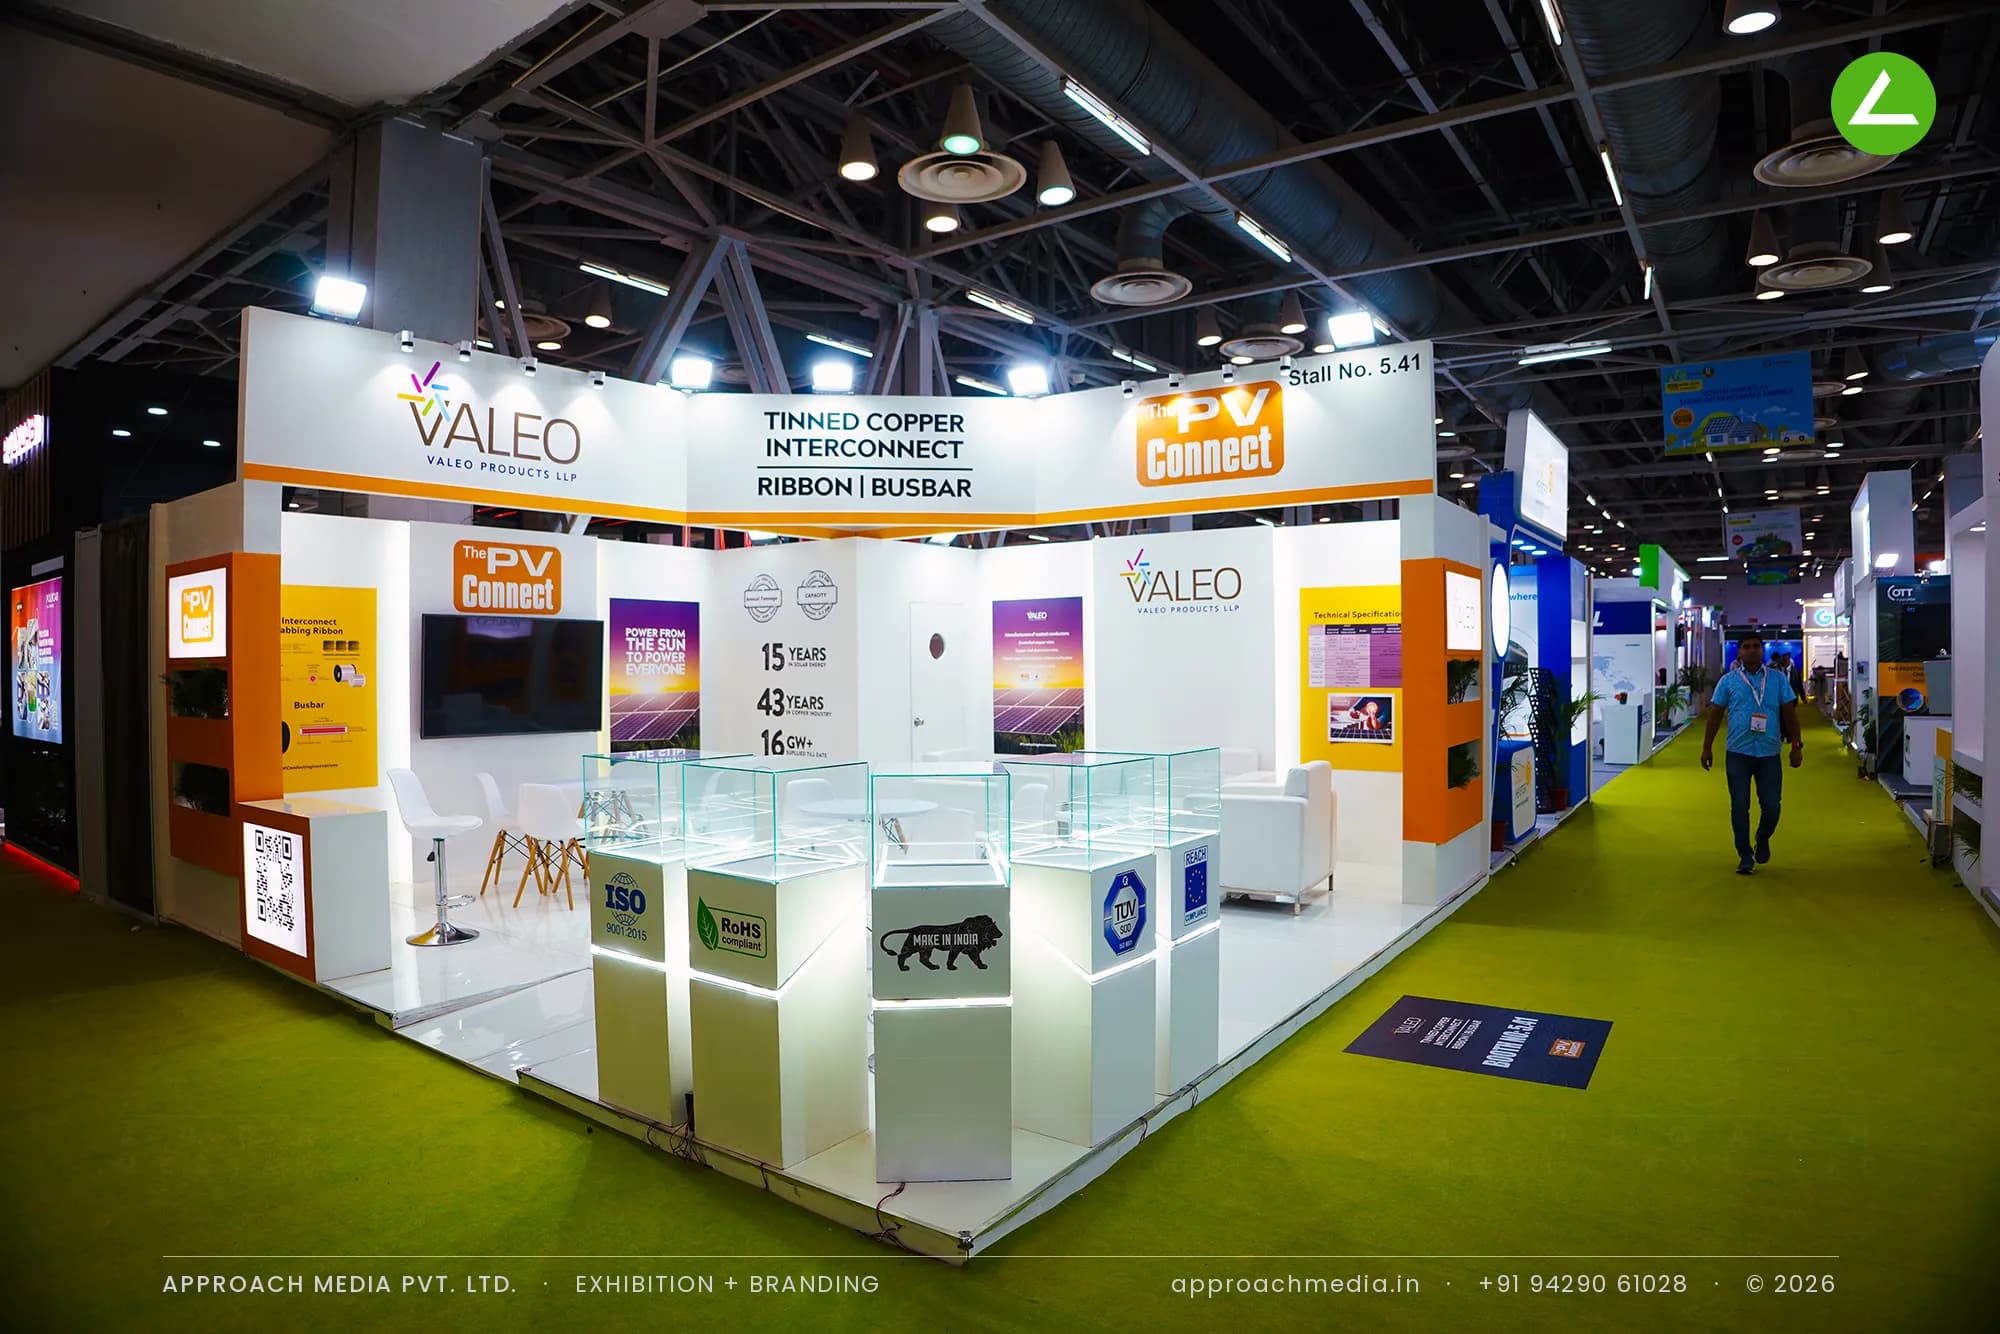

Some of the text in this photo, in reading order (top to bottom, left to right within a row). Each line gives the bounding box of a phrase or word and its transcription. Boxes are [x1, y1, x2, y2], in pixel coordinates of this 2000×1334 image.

[1289, 353, 1420, 386] Stall No. 5.41
[764, 412, 964, 432] TINNED COPPER
[1176, 388, 1270, 434] PV
[408, 399, 580, 465] VALEO
[766, 438, 963, 459] INTERCONNECT
[1147, 425, 1272, 480] Connect
[427, 455, 577, 482] VALEO PRODUCTS LLP
[758, 476, 852, 496] RIBBON
[872, 478, 972, 497] BUSBAR
[463, 545, 553, 577] The PV
[462, 574, 554, 610] Connect
[1126, 567, 1241, 602] VALEO
[190, 589, 211, 613] PV
[1171, 605, 1219, 613] PRODUCTS
[281, 617, 337, 625] Interconnect
[1314, 610, 1402, 619] Technical Specificatio
[280, 626, 343, 636] abbing Ribbon
[625, 627, 685, 638] POWER FROM
[626, 637, 686, 652] THE SUN
[626, 652, 685, 663] TO POWER
[762, 642, 826, 671] 15 YEARS
[626, 663, 685, 676] EVERYONE
[294, 701, 325, 709] Busbar
[757, 687, 824, 717] 43 YEARS
[761, 729, 813, 756] 16 GW+
[1185, 848, 1207, 865] REACH
[605, 884, 646, 915] ISO
[1114, 898, 1137, 921] TÜV
[721, 917, 761, 939] RoHS
[721, 936, 762, 952] compliant
[913, 933, 978, 946] MAKE IN INDIA
[1481, 1040, 1523, 1068] BOOTH
